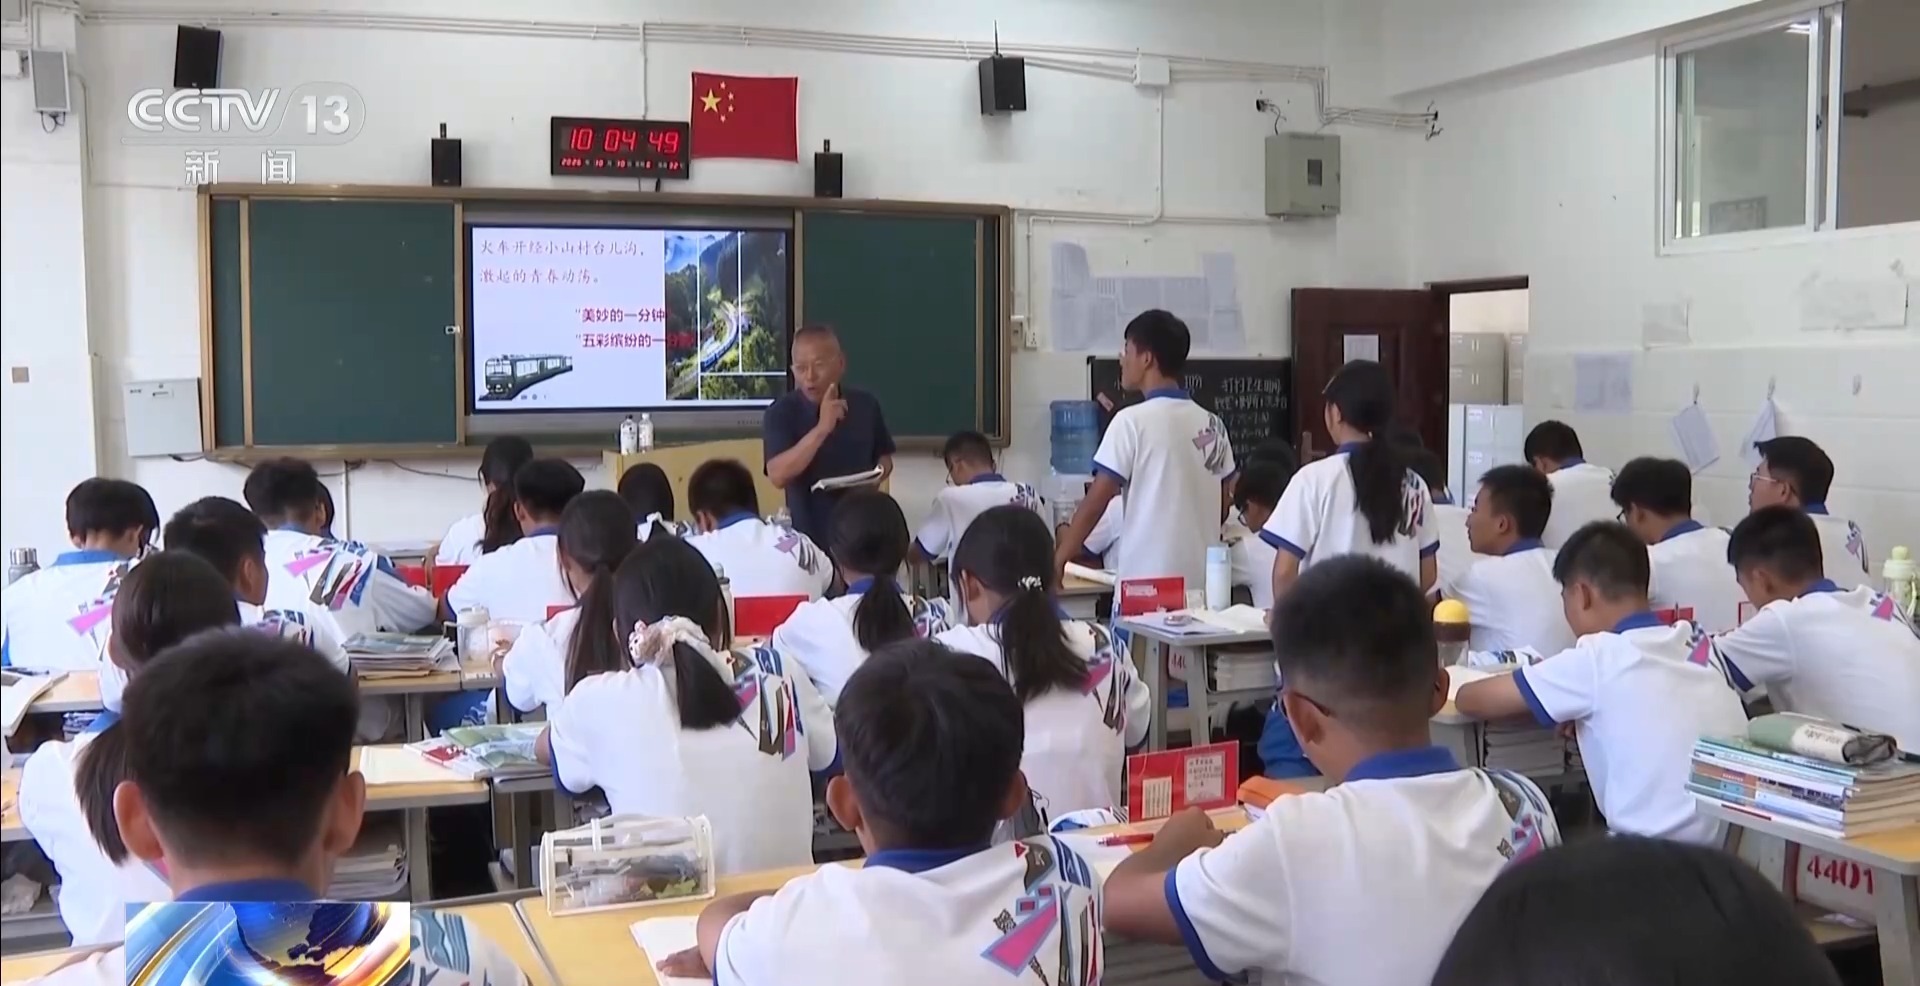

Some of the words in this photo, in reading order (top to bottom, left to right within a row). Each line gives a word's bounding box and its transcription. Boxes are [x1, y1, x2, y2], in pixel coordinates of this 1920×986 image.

[571, 128, 593, 150] 10
[604, 129, 636, 152] 04
[648, 131, 679, 153] 49
[1807, 855, 1874, 895] 4401
